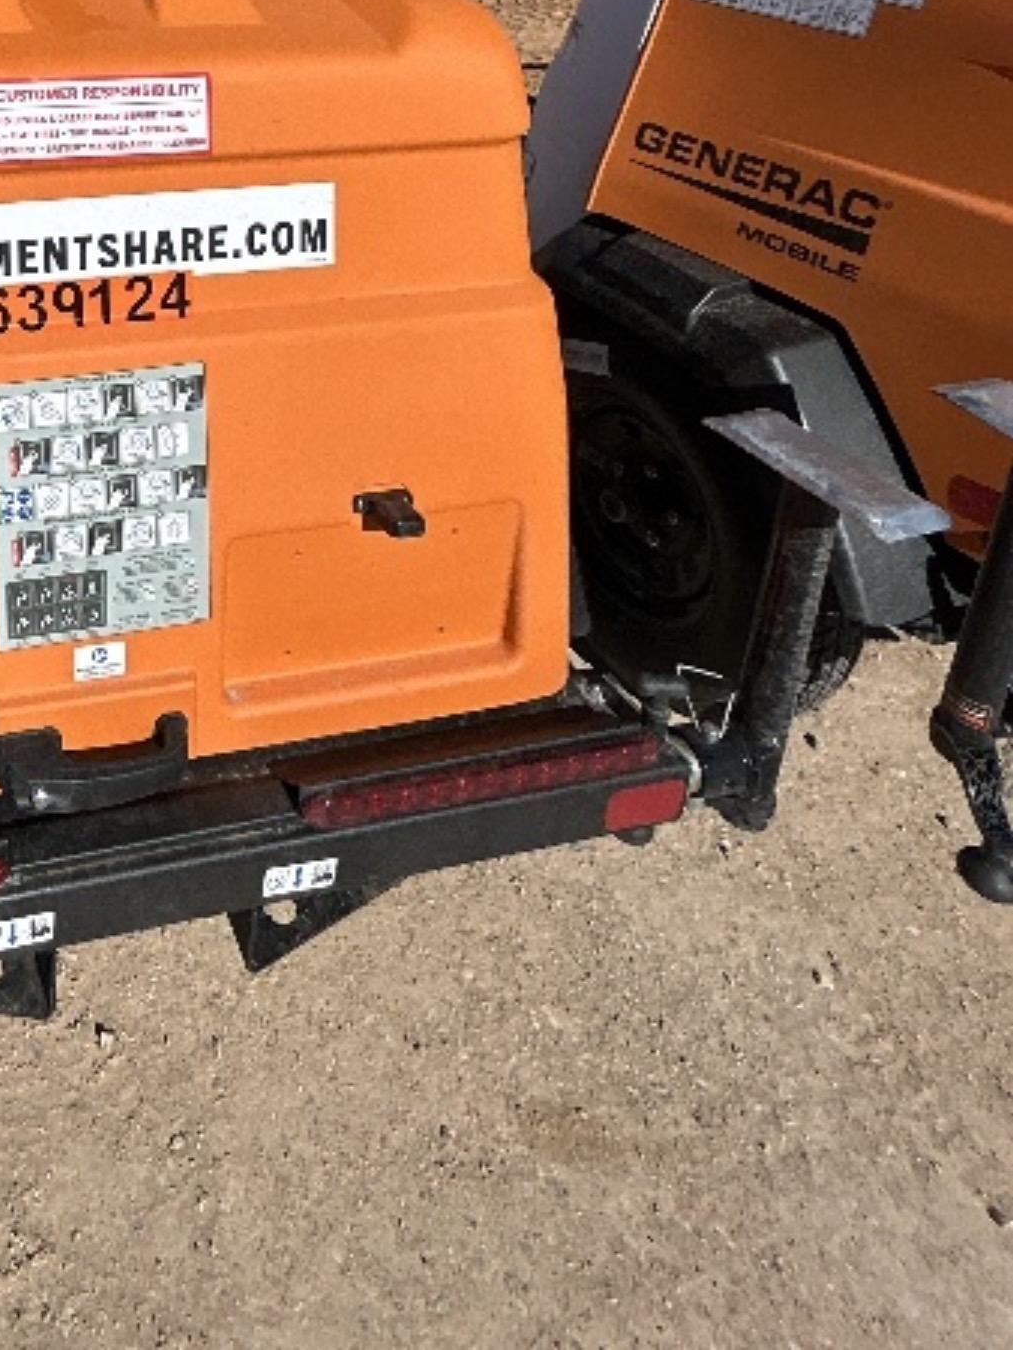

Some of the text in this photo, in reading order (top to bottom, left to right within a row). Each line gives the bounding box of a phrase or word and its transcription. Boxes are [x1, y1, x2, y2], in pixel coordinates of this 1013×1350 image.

[82, 83, 201, 100] RESPONSIBILITY
[634, 122, 881, 230] GENERAC
[736, 221, 862, 283] MOBILE
